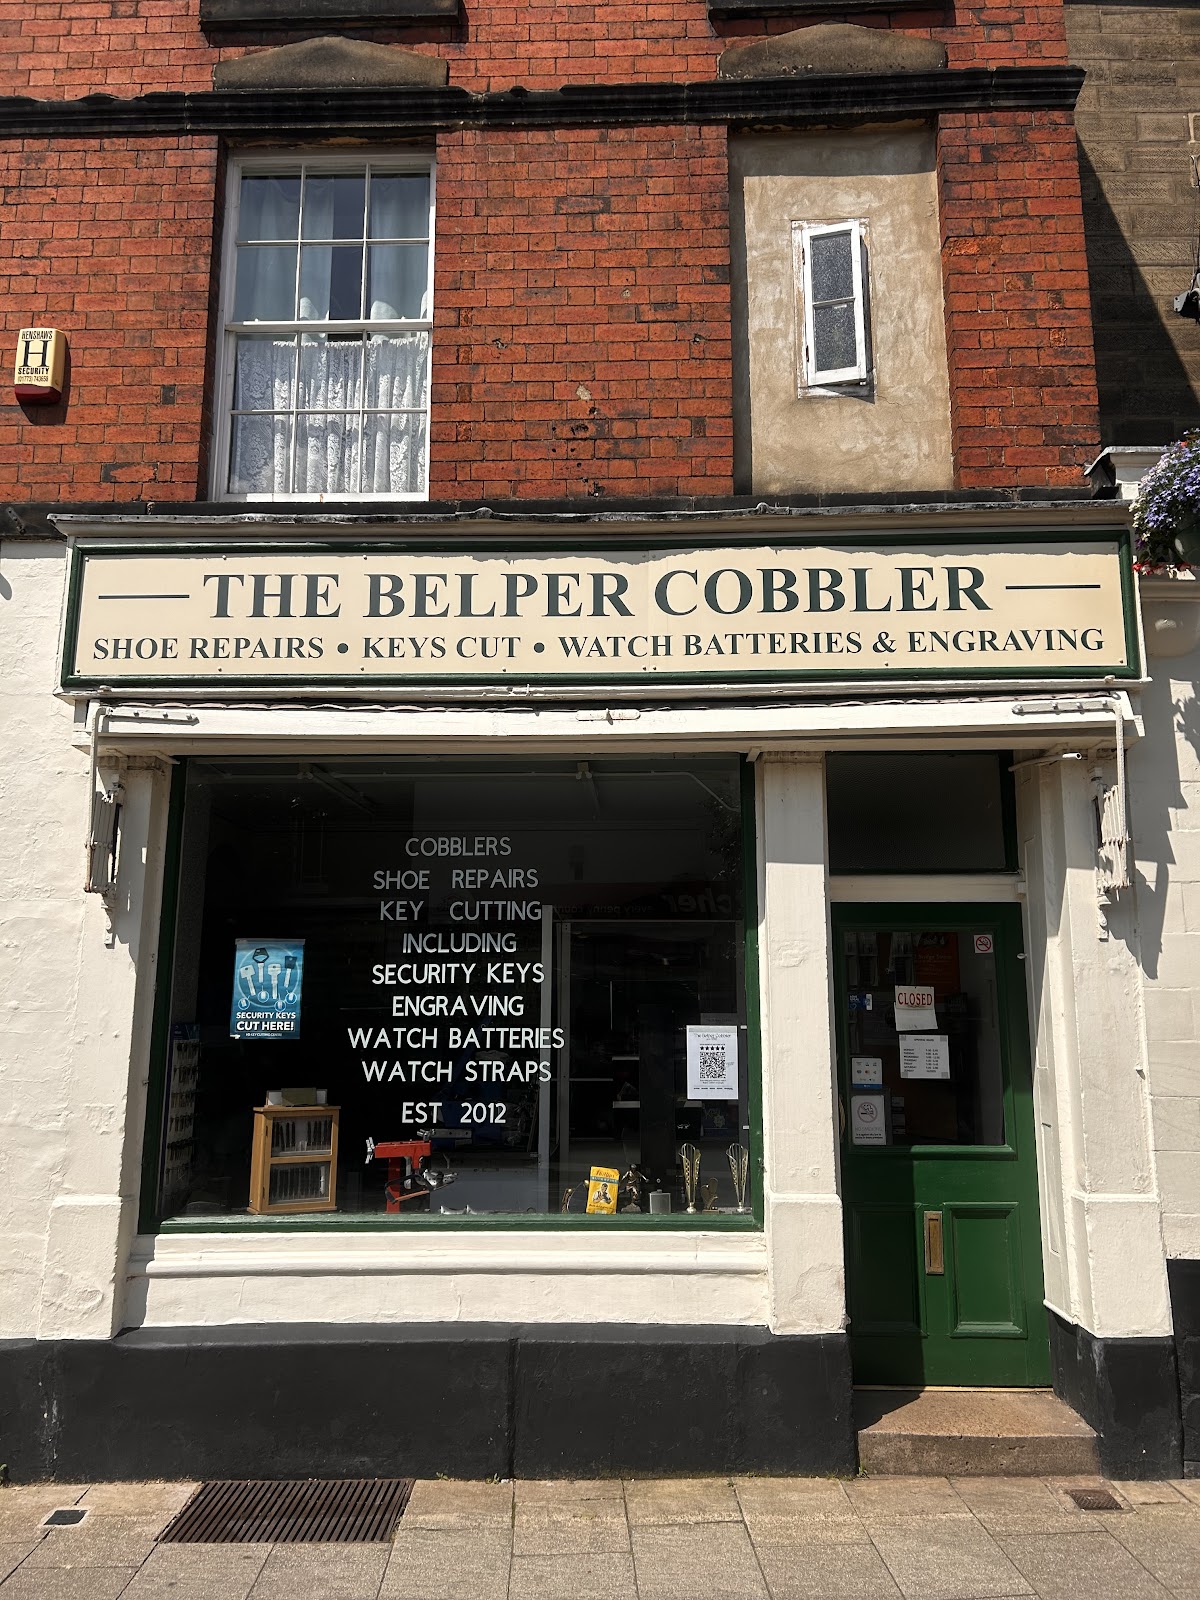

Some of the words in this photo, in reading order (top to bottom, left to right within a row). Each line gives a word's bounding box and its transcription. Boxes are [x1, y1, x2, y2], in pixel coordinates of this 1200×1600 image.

[21, 330, 53, 339] HENSHAWS
[19, 340, 52, 367] H
[203, 574, 342, 618] THE
[362, 572, 636, 618] BELPER
[654, 566, 994, 616] COBBLER
[93, 636, 179, 660] SHOE
[189, 636, 324, 659] REPAIRS
[363, 636, 446, 659] KEYS
[456, 636, 521, 659] CUT
[557, 635, 672, 658] WATCH
[683, 631, 863, 656] BATTERIES
[871, 631, 898, 654] &
[907, 628, 1104, 653] ENGRAVING
[405, 836, 512, 857] COBBLERS
[373, 870, 430, 890] SHOE
[451, 868, 539, 889] REPAIRS
[380, 900, 425, 921] KEY
[449, 900, 542, 921] CUTTING
[402, 932, 517, 954] INCLUDING
[371, 963, 477, 985] SECURITY
[487, 962, 545, 984] KEYS
[392, 995, 525, 1017] ENGRAVING
[897, 992, 933, 1007] CLOSED
[237, 1021, 259, 1030] CUT
[262, 1021, 294, 1030] HERE!
[347, 1027, 438, 1049] WATCH
[448, 1027, 565, 1049] BATTERIES
[361, 1060, 453, 1083] WATCH
[464, 1060, 552, 1082] STRAPS
[401, 1102, 443, 1124] EST
[460, 1102, 507, 1124] 2012
